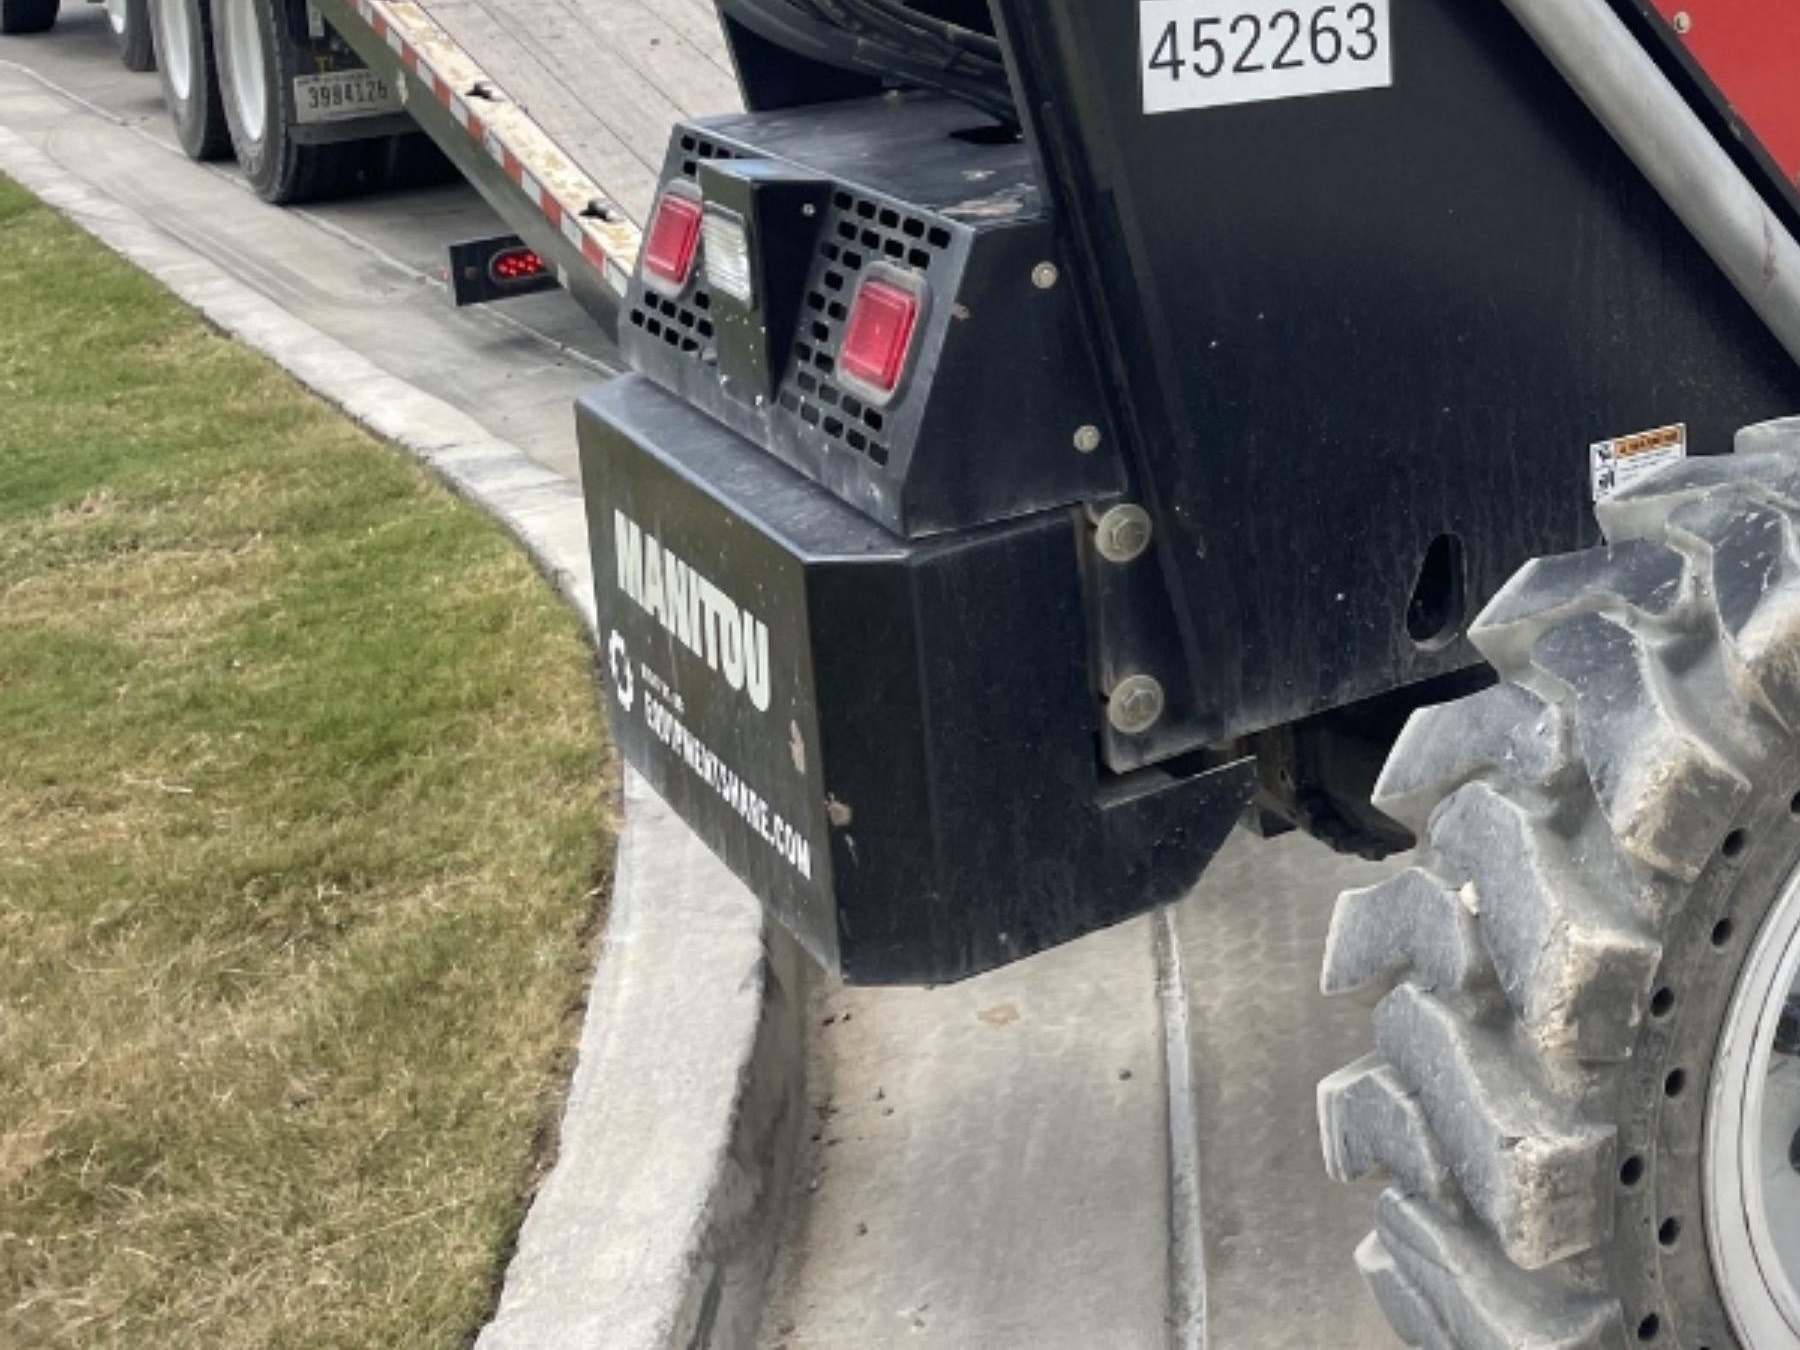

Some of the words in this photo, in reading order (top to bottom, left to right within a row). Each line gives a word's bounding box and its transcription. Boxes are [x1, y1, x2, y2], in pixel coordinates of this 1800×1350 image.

[1147, 2, 1379, 81] 452263
[613, 507, 771, 713] MANITOU
[643, 688, 813, 881] EQUIPMENTSHARE.COM
